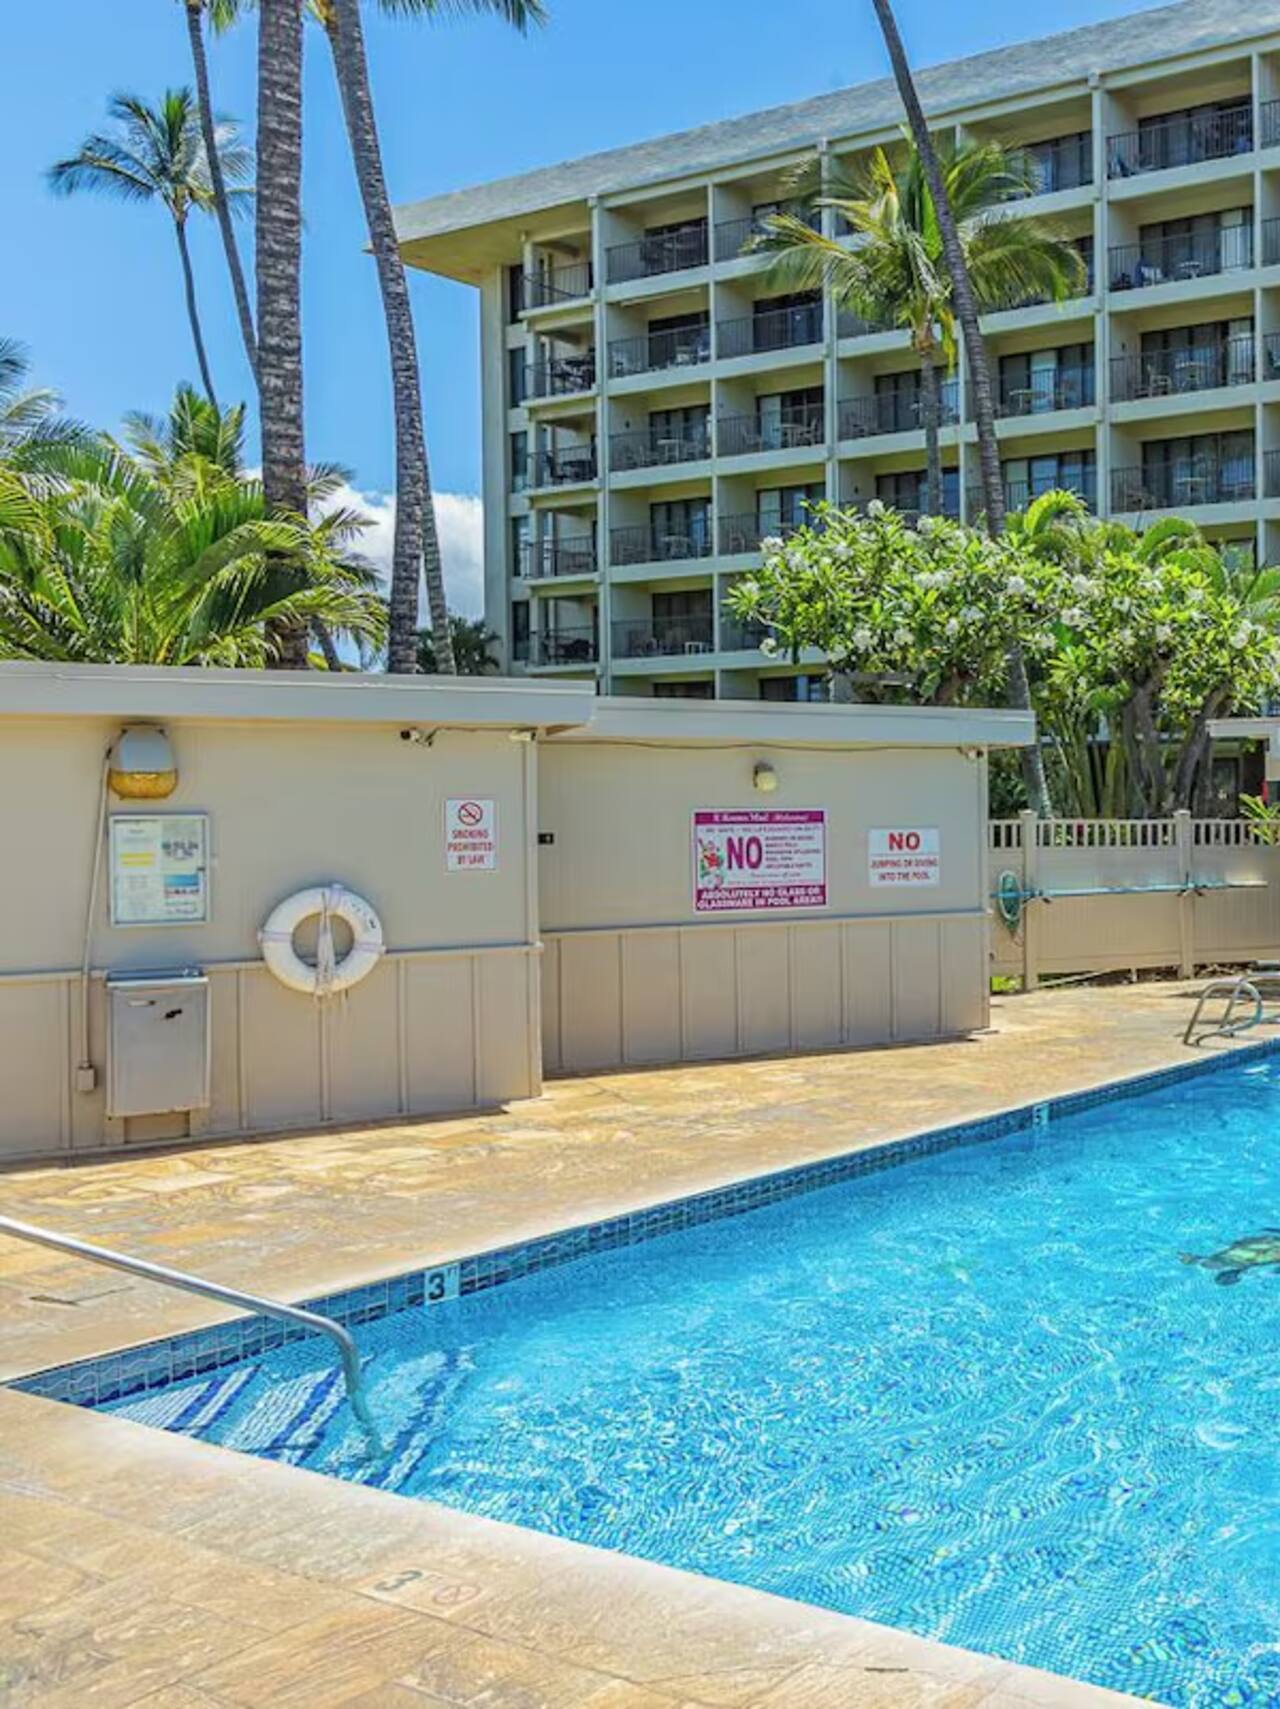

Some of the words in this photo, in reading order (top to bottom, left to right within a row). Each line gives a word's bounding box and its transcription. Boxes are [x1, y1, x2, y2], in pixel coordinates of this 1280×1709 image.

[888, 831, 921, 851] NO
[726, 835, 763, 870] NO
[912, 871, 930, 880] POOL
[767, 896, 792, 906] POOL
[428, 1272, 446, 1301] 3
[374, 1569, 423, 1592] 3
